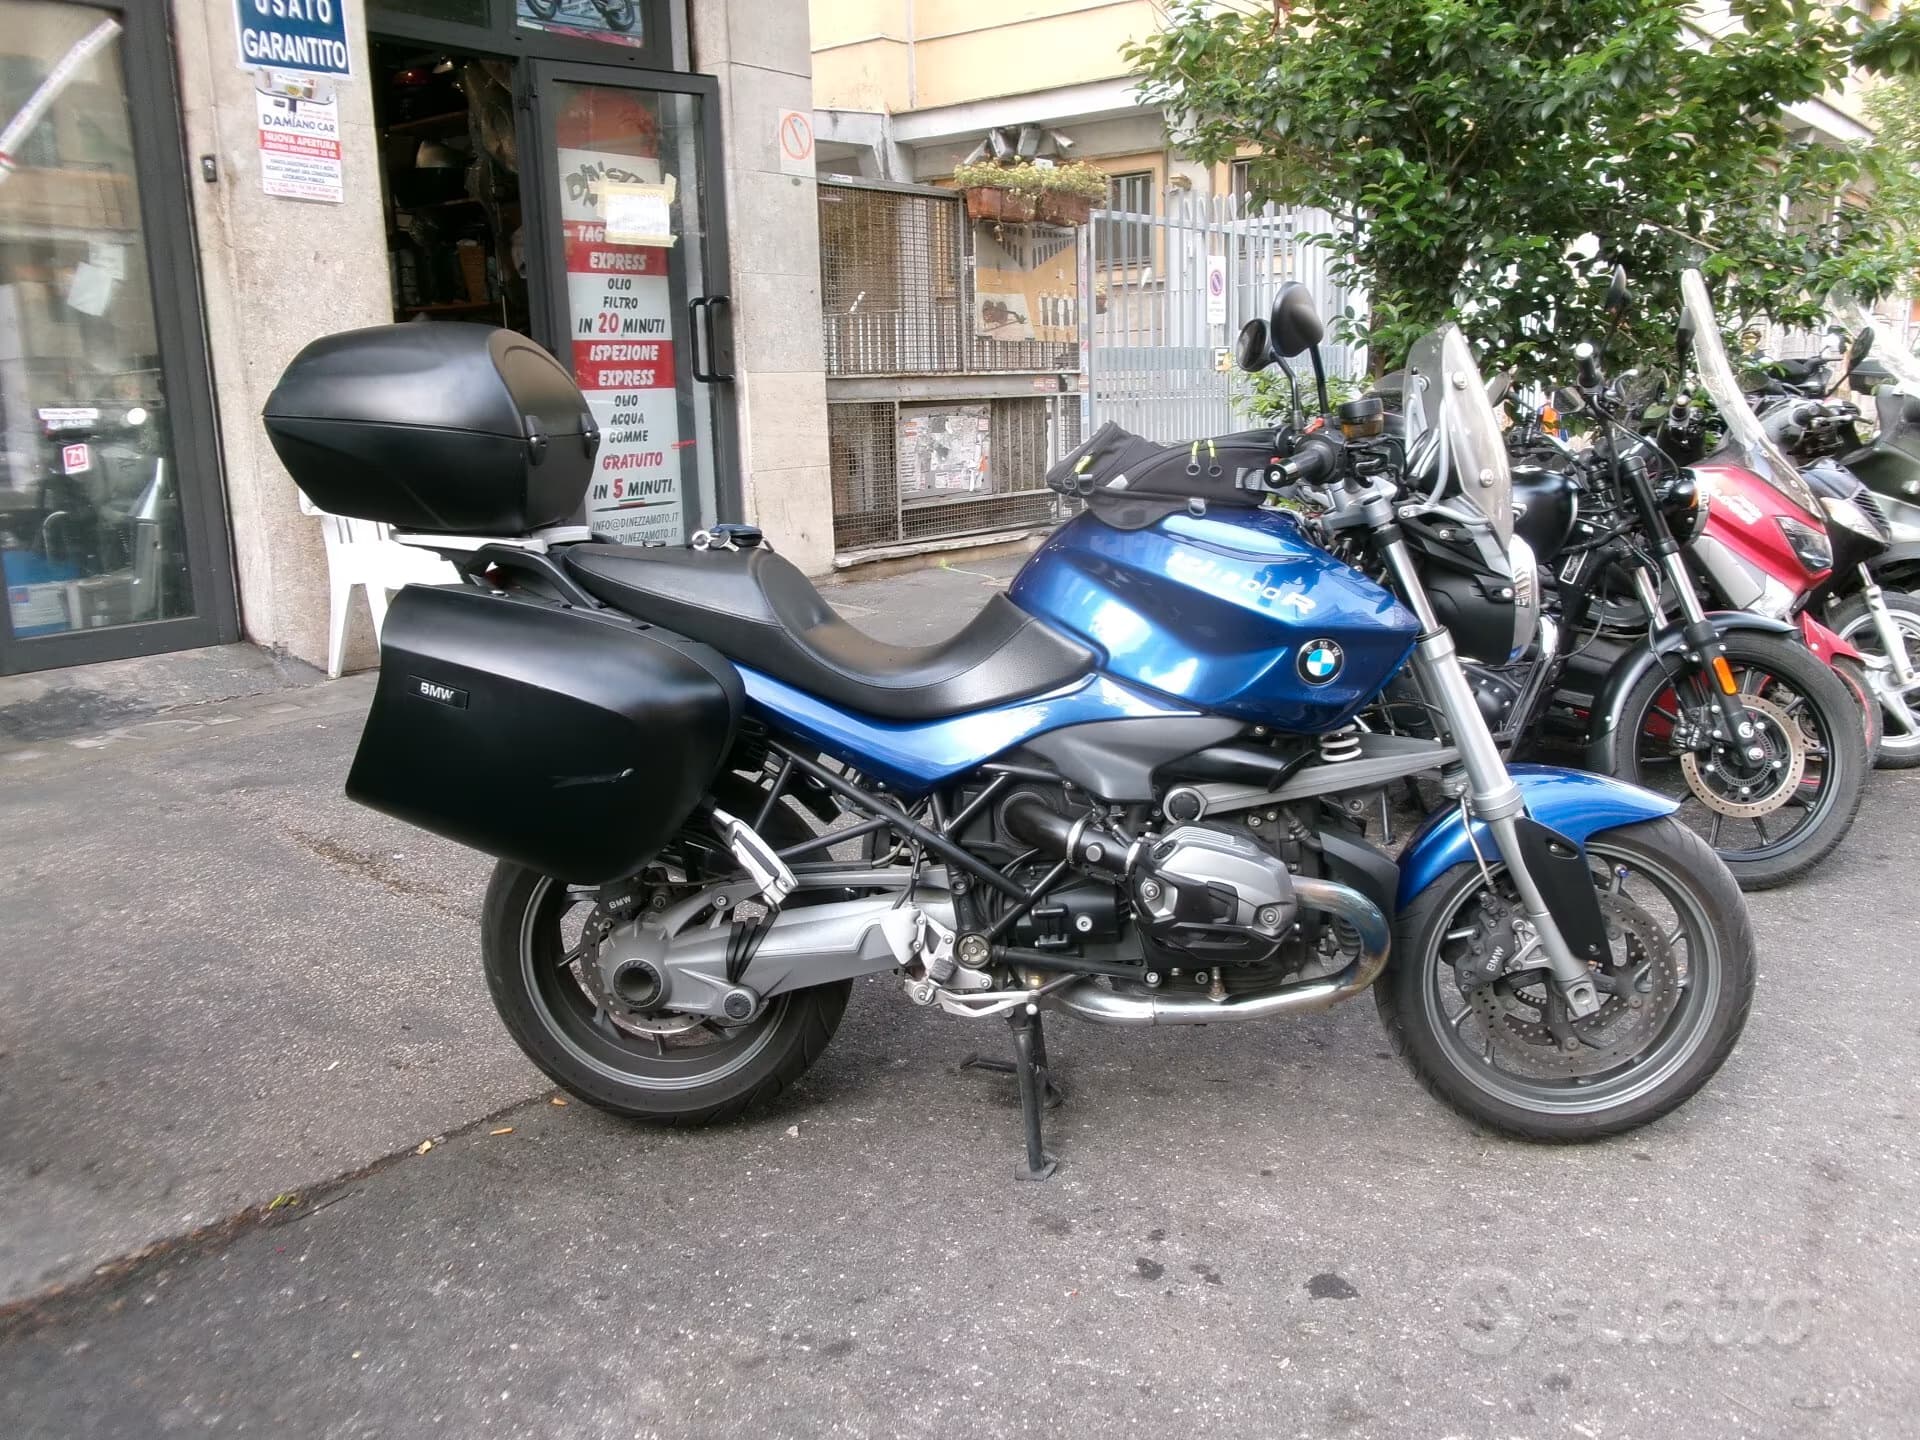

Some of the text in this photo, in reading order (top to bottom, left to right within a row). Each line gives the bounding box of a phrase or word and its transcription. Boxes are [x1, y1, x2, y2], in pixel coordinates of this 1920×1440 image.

[243, 28, 346, 68] GARANTITO
[263, 113, 316, 130] DAMIANO
[317, 122, 335, 133] CAR
[589, 251, 648, 271] EXPRESS
[607, 278, 632, 290] OLIO
[603, 296, 639, 310] FILTRO
[578, 312, 665, 334] IN 20 MINUTI
[590, 344, 660, 362] ISPEZIONE
[598, 369, 656, 387] EXPRESS
[614, 394, 639, 407] OLIO
[610, 413, 644, 426] ACQUA
[608, 430, 649, 444] GOMME
[602, 452, 663, 471] GRATUITO
[592, 484, 608, 500] IN
[613, 478, 624, 499] 5
[420, 681, 455, 701] BMW
[608, 895, 631, 909] BMW
[1486, 945, 1504, 972] BMW
